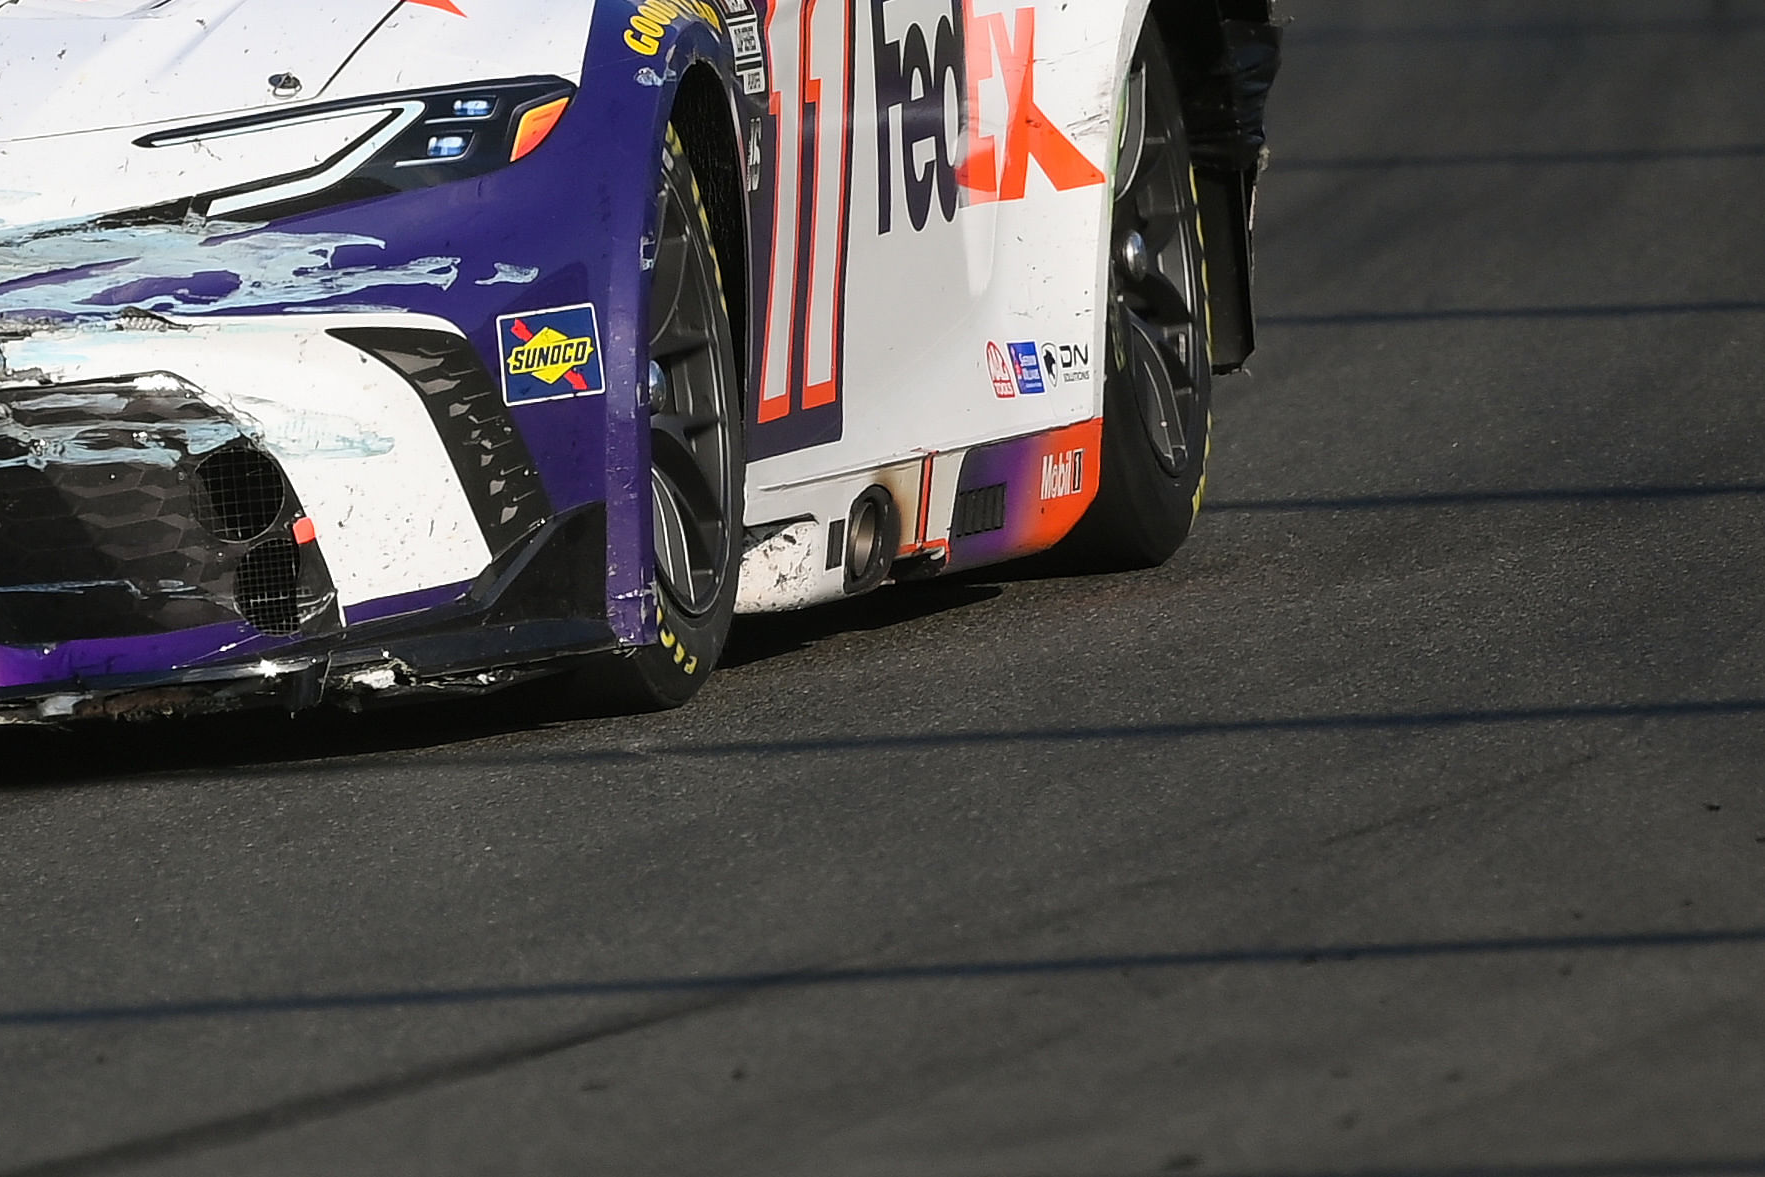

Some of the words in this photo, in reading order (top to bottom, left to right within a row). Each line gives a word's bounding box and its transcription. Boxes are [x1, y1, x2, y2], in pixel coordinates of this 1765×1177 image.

[512, 341, 588, 371] SUNOCO
[1058, 343, 1089, 368] DN
[1040, 450, 1072, 501] Mobil
